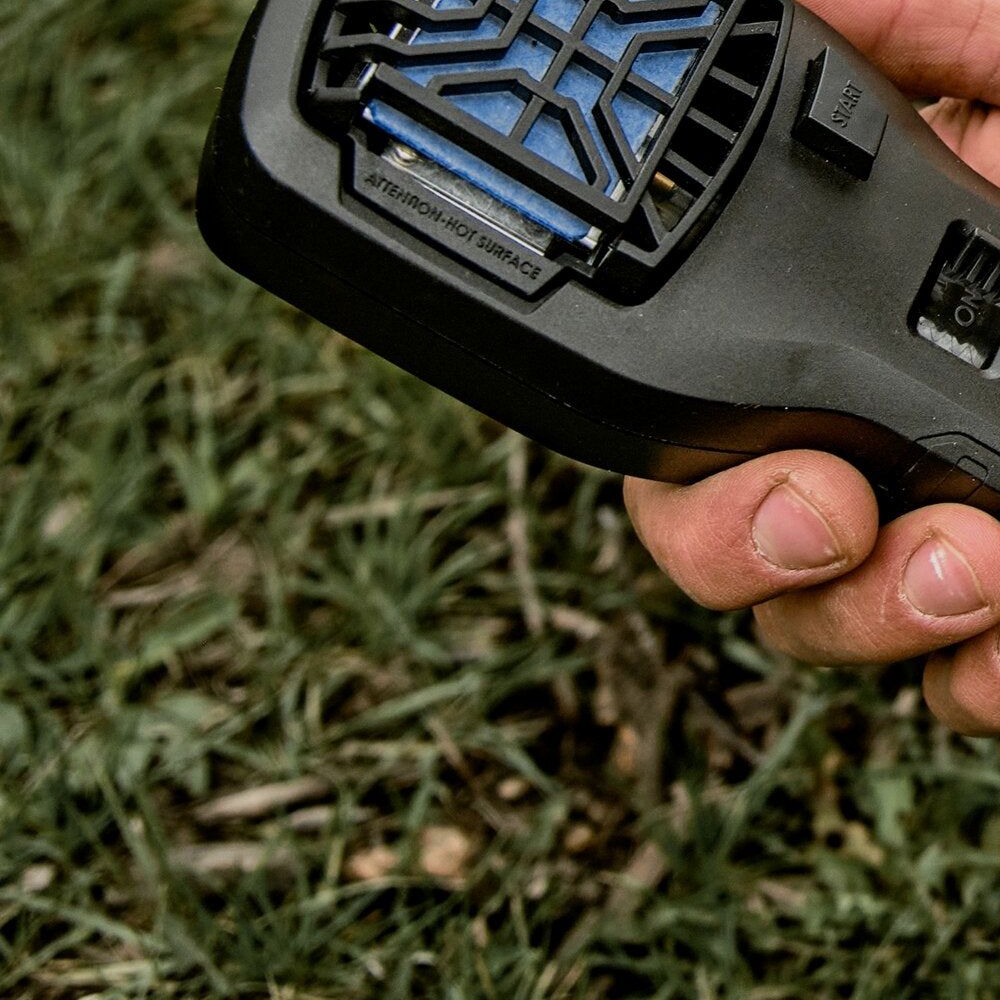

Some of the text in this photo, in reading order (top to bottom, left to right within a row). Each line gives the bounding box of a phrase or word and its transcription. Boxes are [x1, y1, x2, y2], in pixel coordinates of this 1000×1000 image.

[831, 80, 863, 128] START
[477, 236, 542, 281] SURFACE
[955, 287, 981, 327] ON
